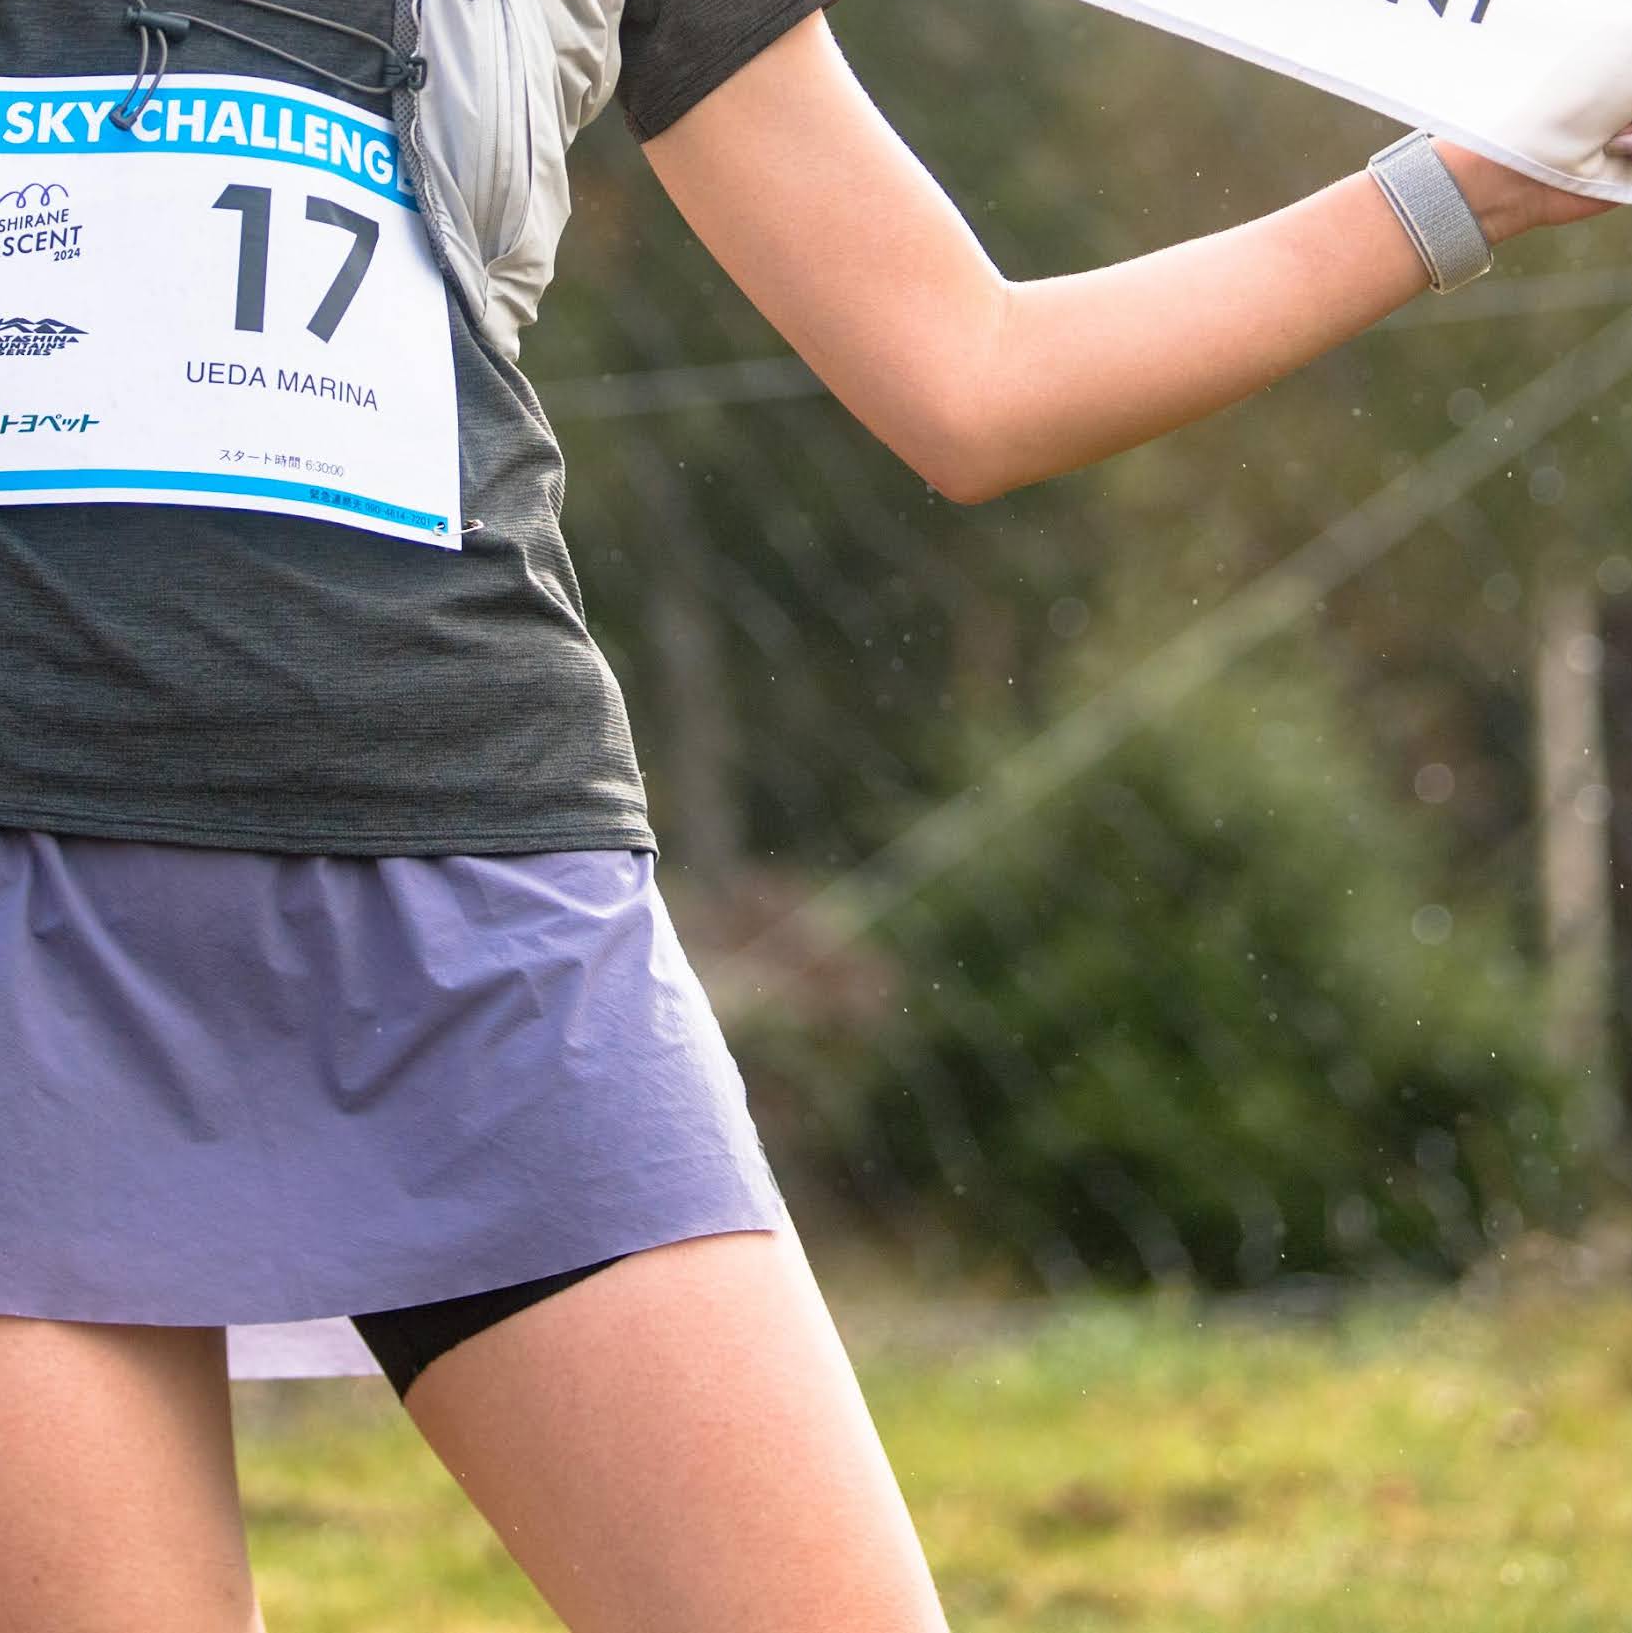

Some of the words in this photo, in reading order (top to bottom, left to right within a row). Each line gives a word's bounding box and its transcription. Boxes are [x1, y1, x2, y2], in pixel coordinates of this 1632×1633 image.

[2, 100, 111, 144] SKY
[54, 248, 80, 262] 2024
[211, 183, 380, 345] 17
[186, 361, 266, 388] UEDA
[277, 369, 378, 411] MARINA
[219, 449, 301, 469] スタート時間
